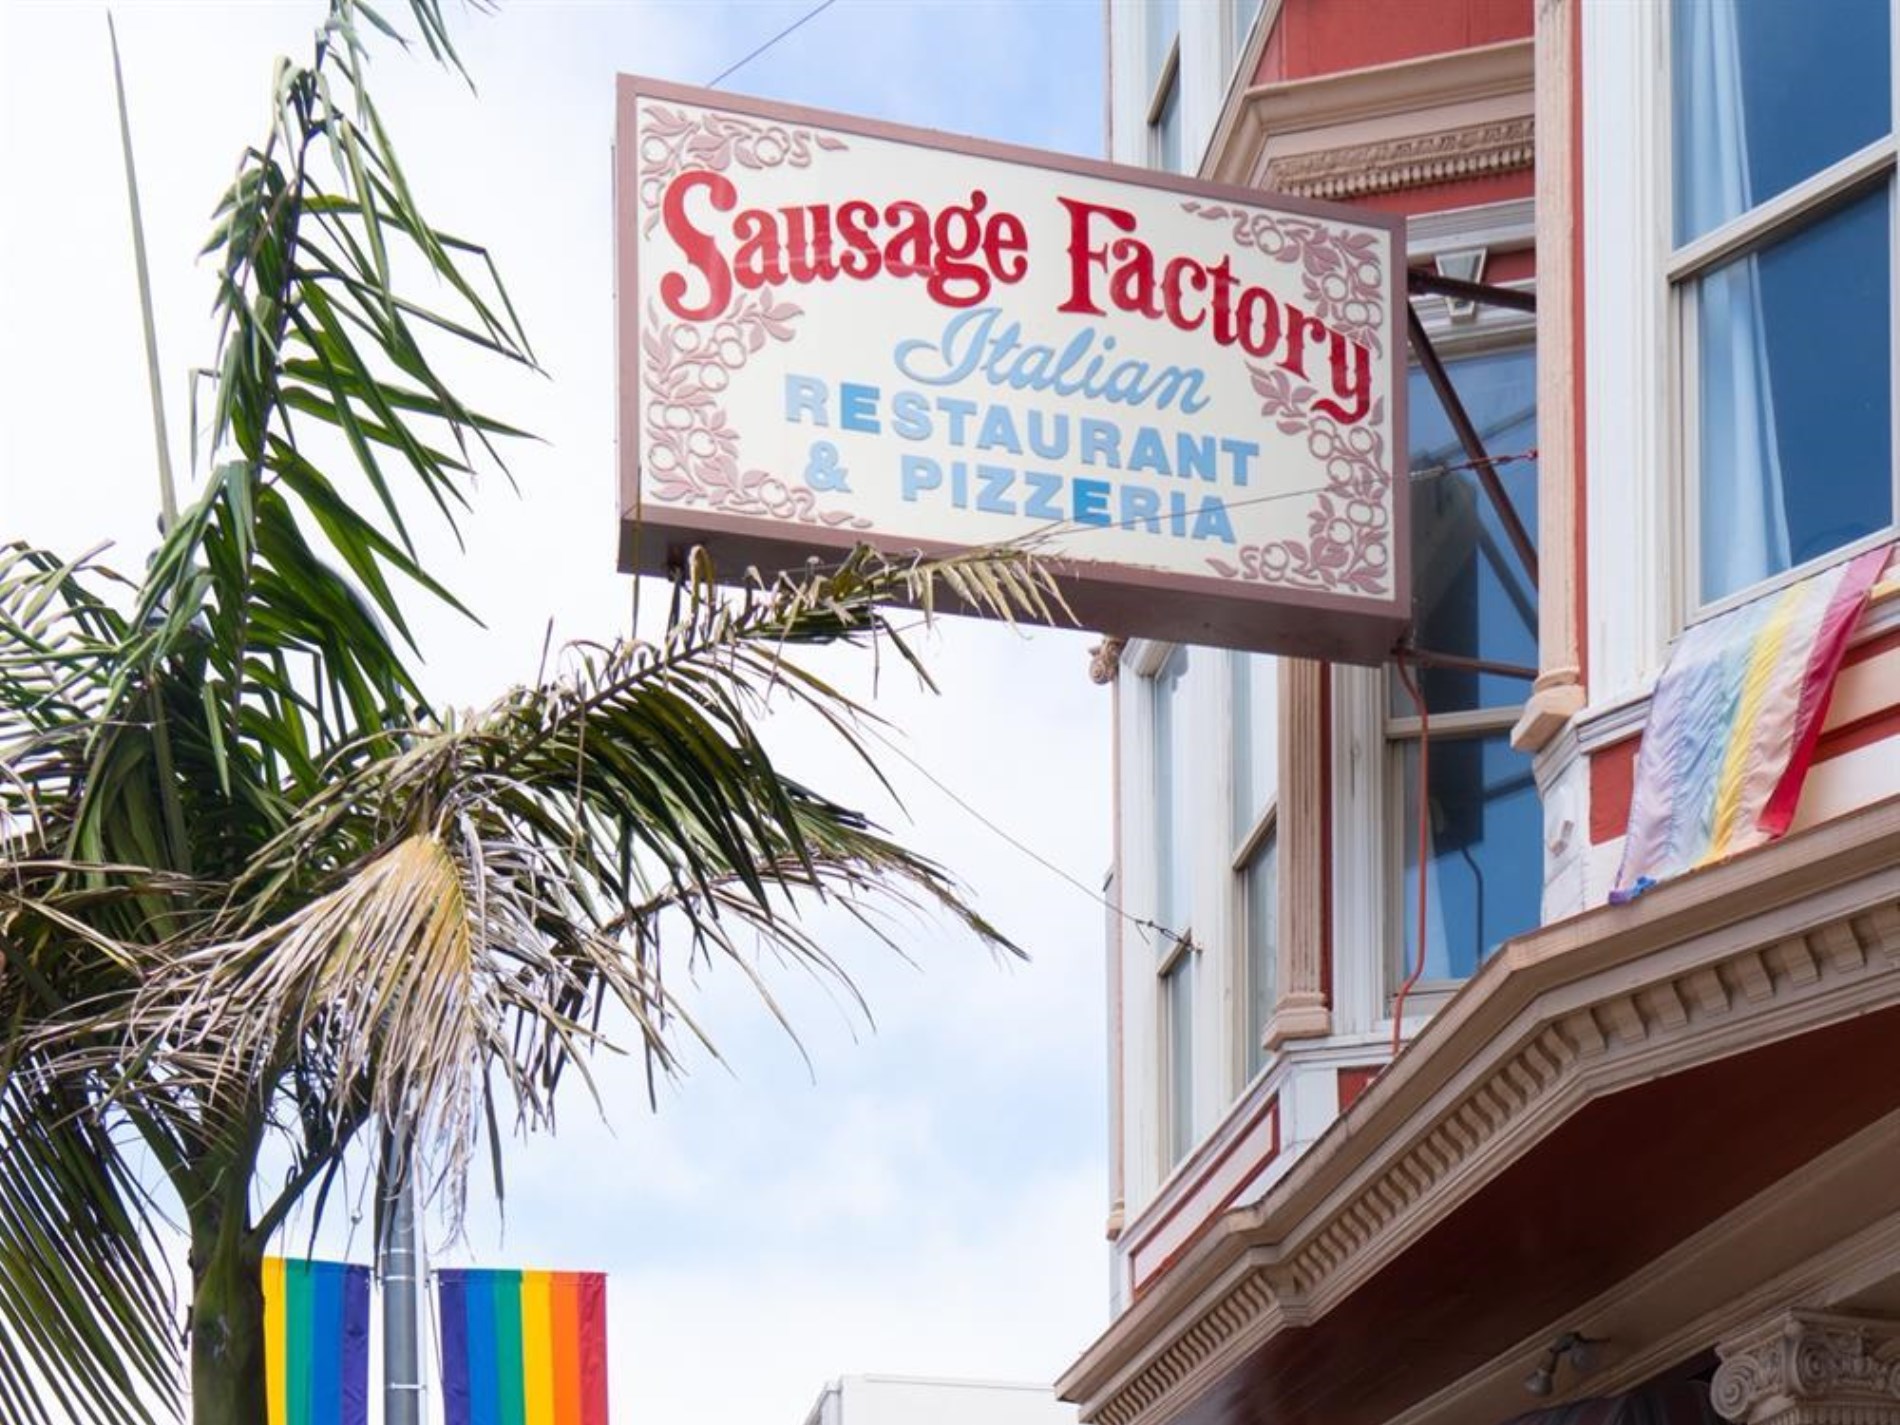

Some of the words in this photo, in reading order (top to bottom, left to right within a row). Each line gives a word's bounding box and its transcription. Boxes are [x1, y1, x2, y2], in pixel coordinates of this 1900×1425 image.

[661, 169, 1028, 321] Sausage
[1057, 196, 1373, 425] Factory
[893, 306, 1210, 416] Italian
[784, 373, 1260, 487] RESTAURANT
[804, 441, 850, 493] &
[901, 457, 1237, 544] PIZZERIA
